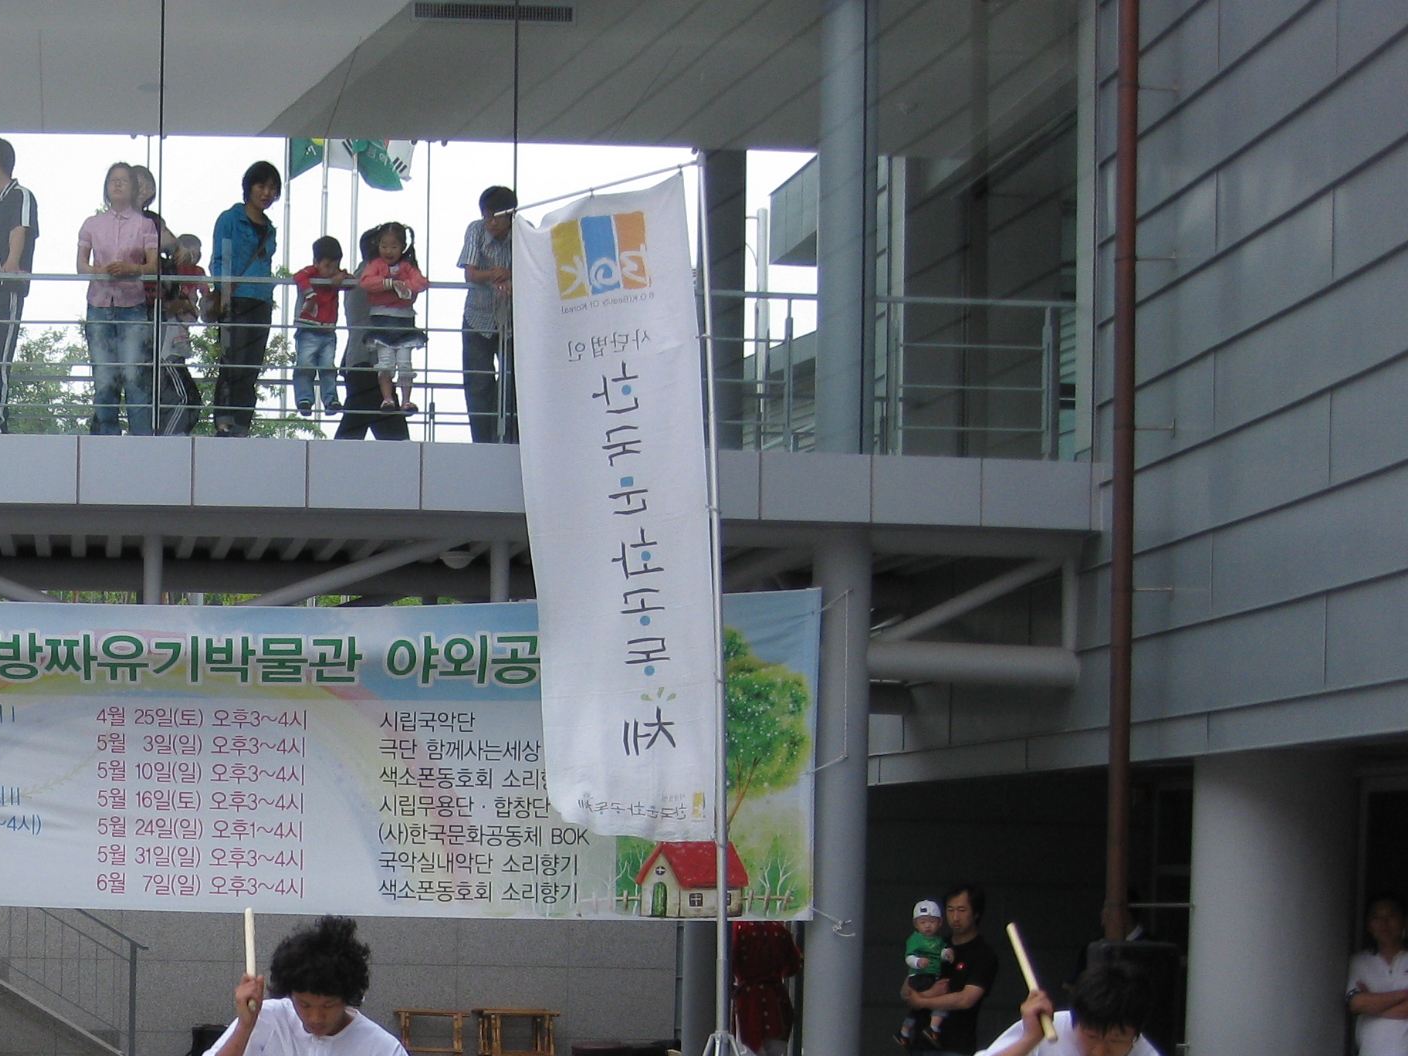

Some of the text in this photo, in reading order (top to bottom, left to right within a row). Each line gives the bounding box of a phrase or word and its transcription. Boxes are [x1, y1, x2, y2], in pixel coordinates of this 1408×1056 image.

[95, 706, 307, 731] 4월 25일(토) 오후3~4시
[378, 711, 476, 733] 시립국악단
[96, 732, 306, 758] 5월 3일(일) 오후3~4시
[378, 738, 542, 763] 극단 함께사는세상
[96, 759, 305, 786] 5월 10일(일) 오후3~4시
[378, 766, 493, 790] 색소폰동호회
[96, 787, 304, 814] 5월 16일(토) 오후3~4시
[378, 795, 475, 818] 시립무용단
[493, 796, 552, 819] 합창단
[97, 816, 303, 843] 5월 24일(일) 오후1~4시
[378, 822, 591, 847] (사)한국문화공동체 BOK
[97, 843, 304, 871] 5월 31일(일) 오후3~4시
[378, 851, 578, 876] 국악실내악단 소리향기
[96, 872, 304, 899] 6월 7일(일) 오후3~4시
[378, 879, 578, 904] 색소폰동호회 소리향기
